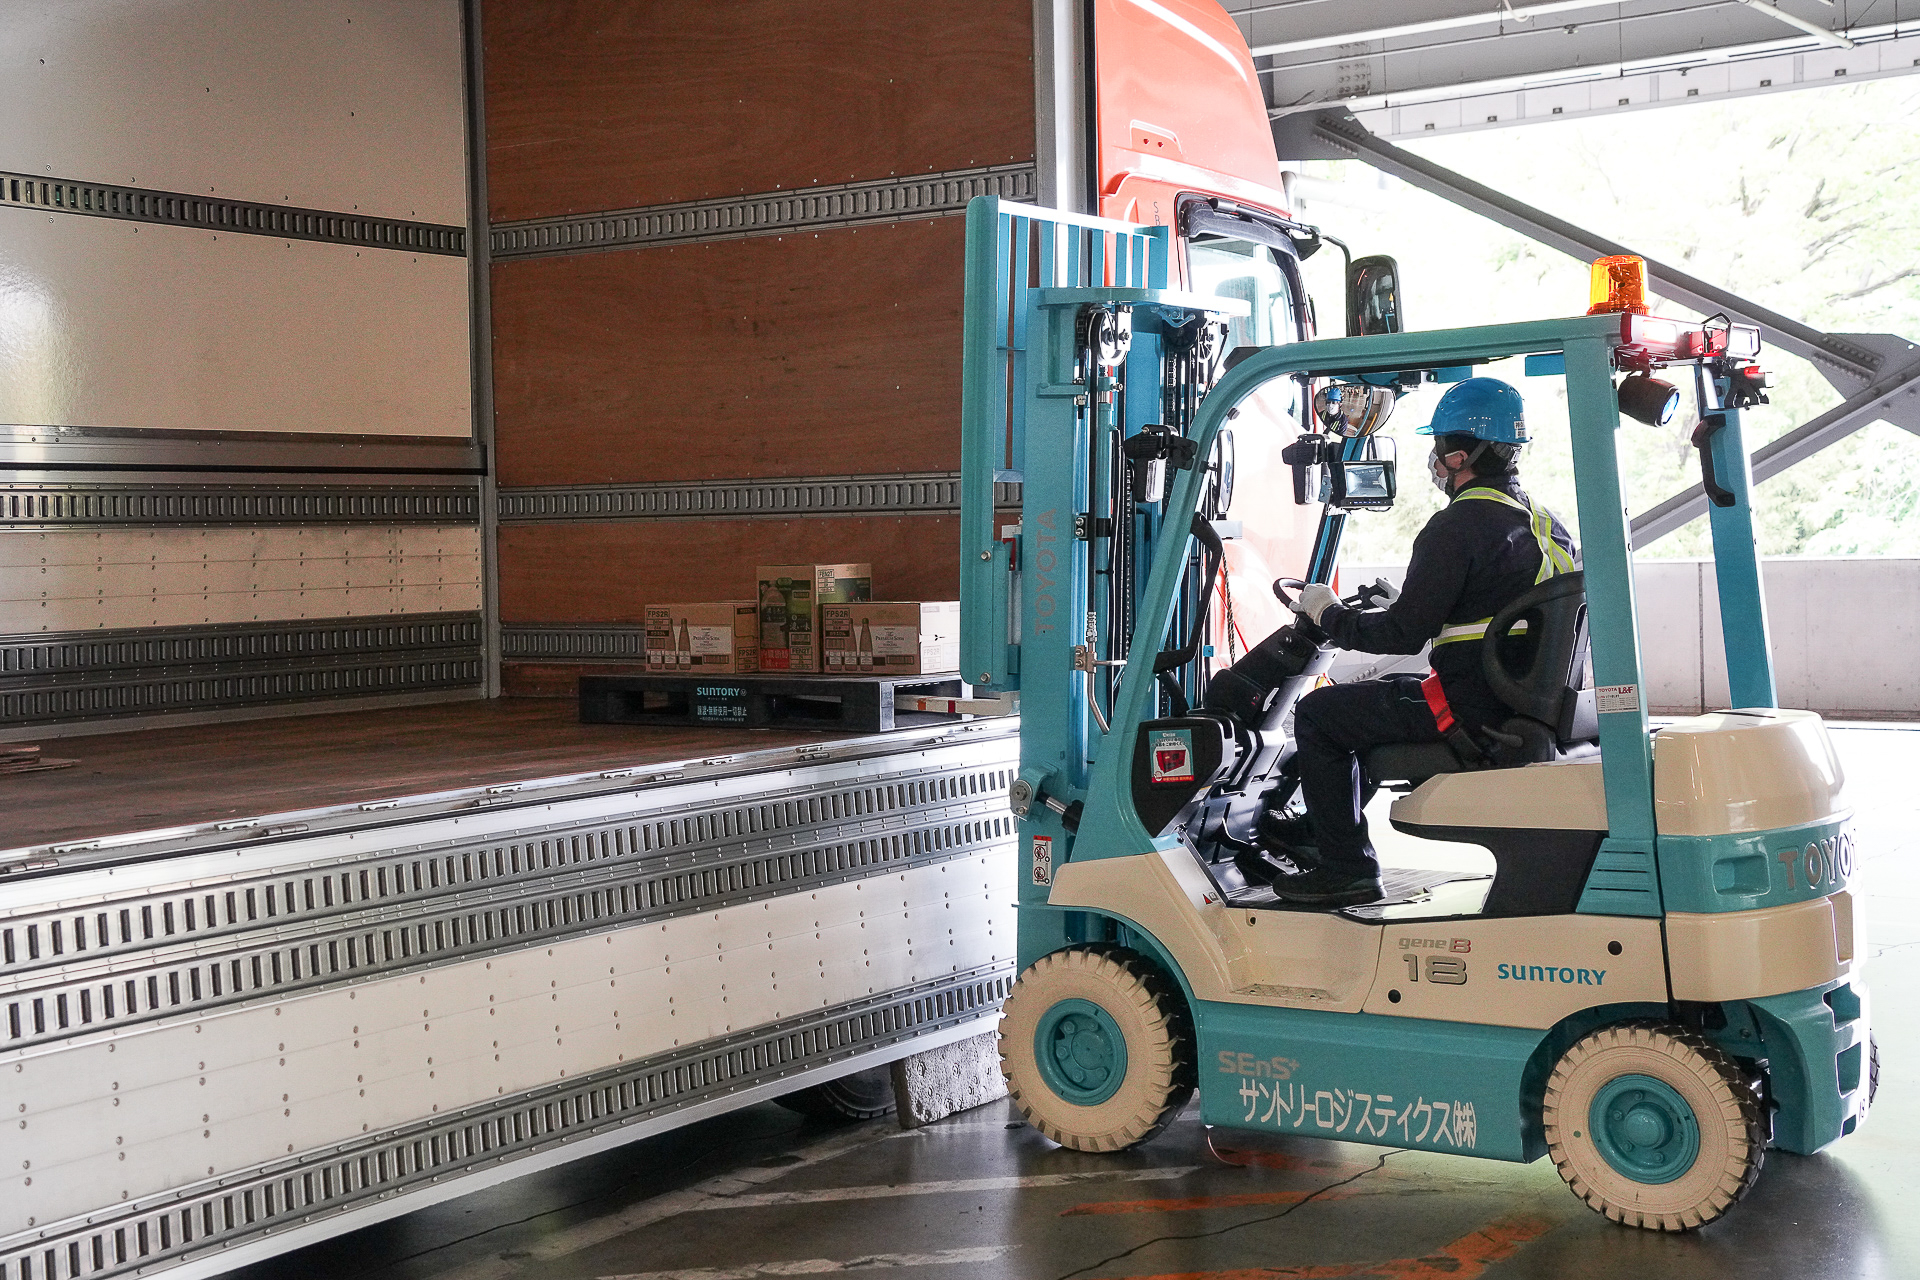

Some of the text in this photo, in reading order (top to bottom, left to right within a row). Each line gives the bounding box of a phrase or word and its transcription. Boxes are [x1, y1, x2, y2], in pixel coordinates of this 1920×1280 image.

[1035, 508, 1057, 636] TOYOTA
[647, 610, 669, 618] FPS2R
[826, 610, 848, 618] FPS2R
[696, 687, 740, 696] SUNTORY
[1618, 686, 1634, 695] L&F
[1777, 831, 1858, 889] TOYO
[1403, 954, 1468, 985] 18
[1497, 963, 1607, 986] SUNTORY
